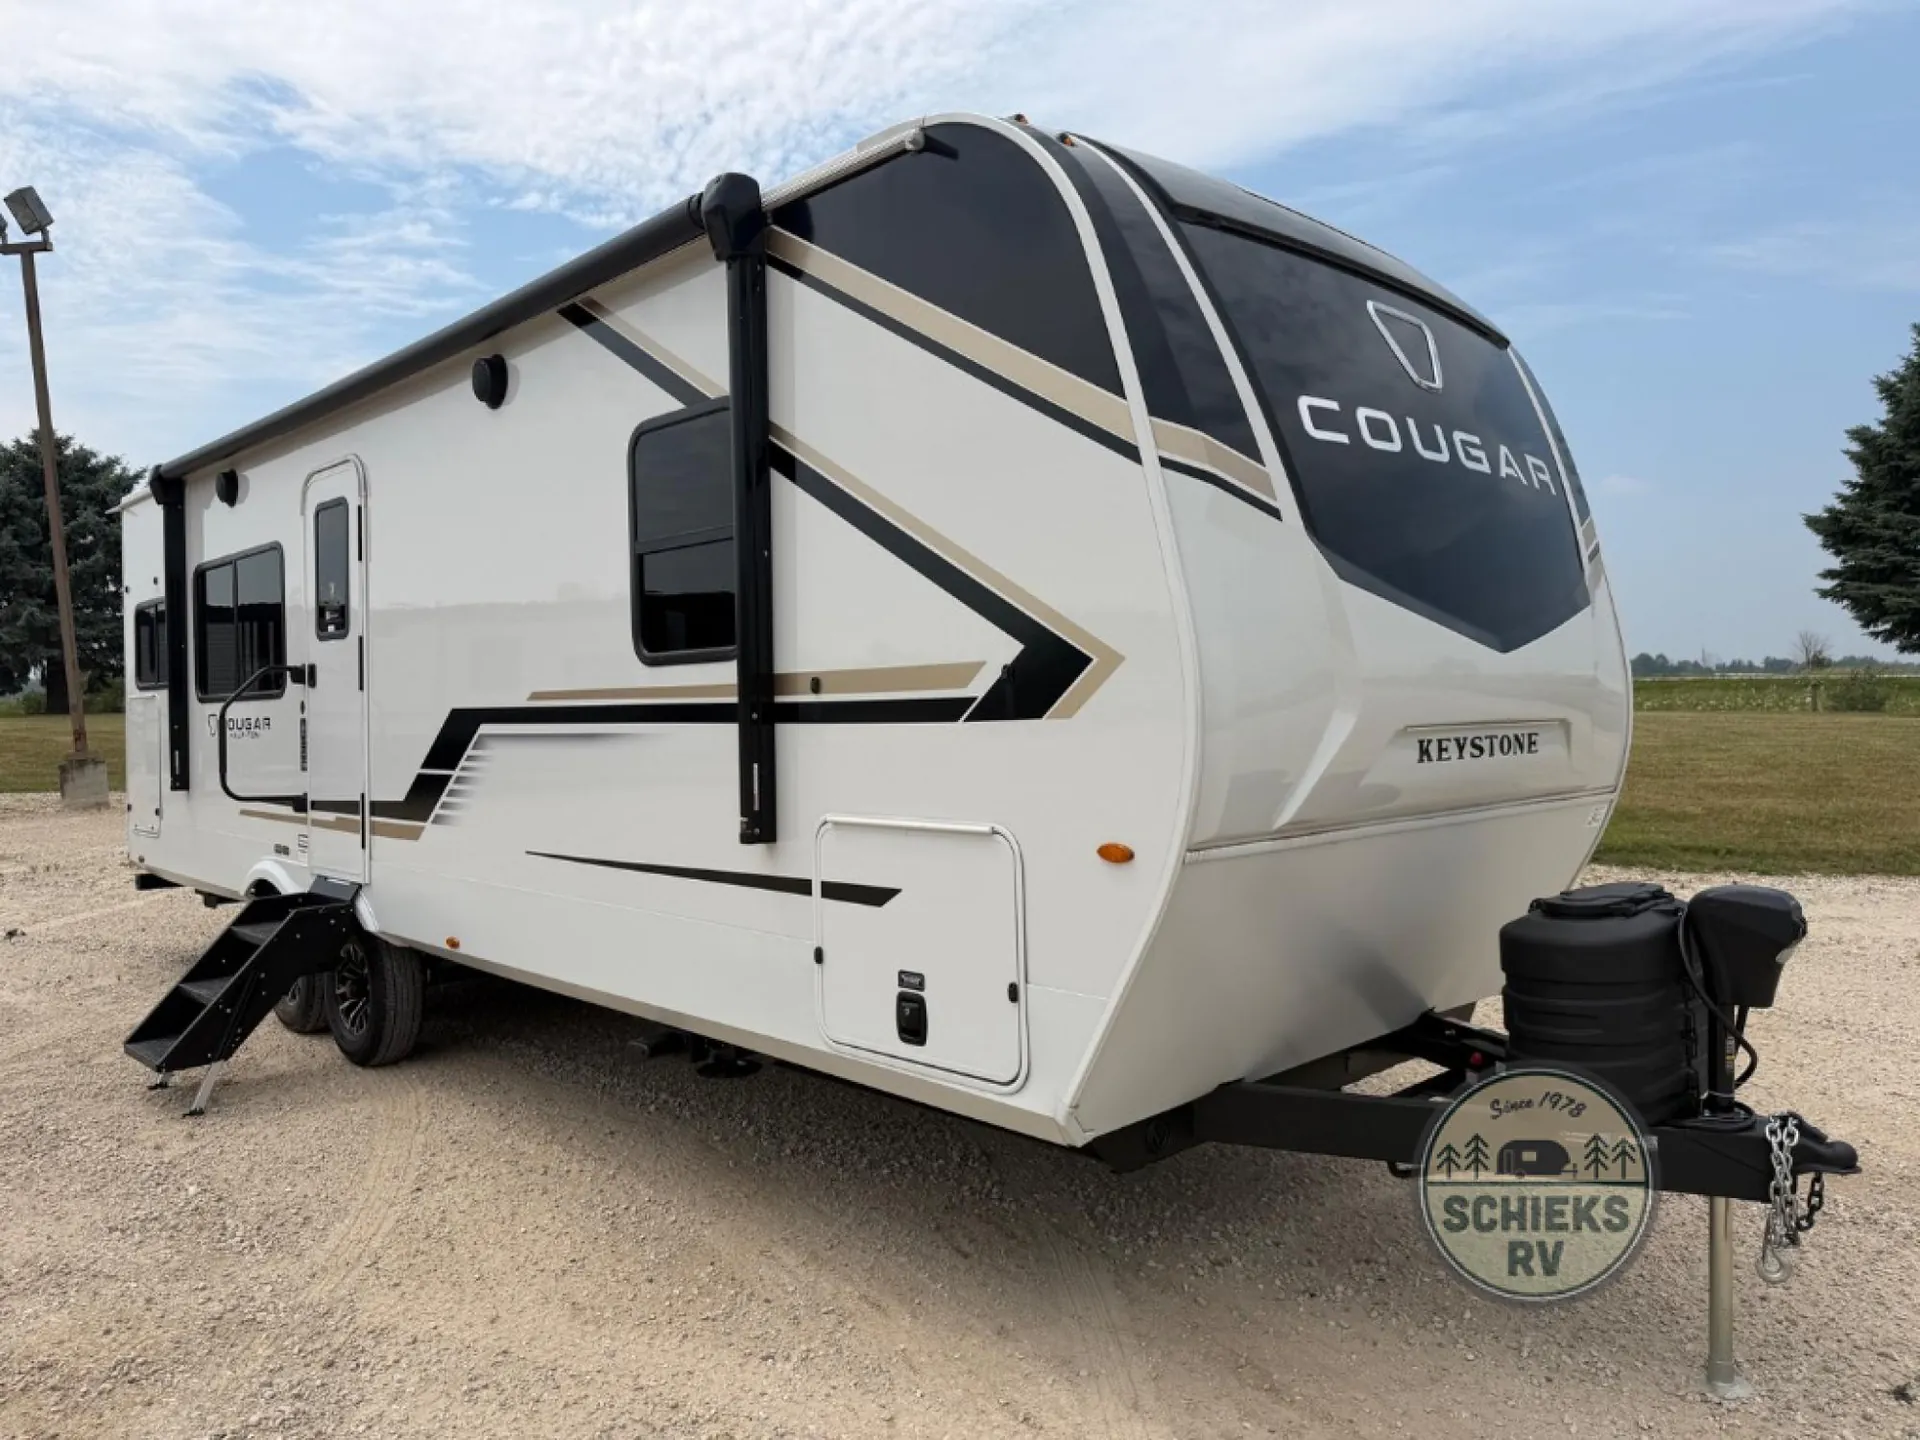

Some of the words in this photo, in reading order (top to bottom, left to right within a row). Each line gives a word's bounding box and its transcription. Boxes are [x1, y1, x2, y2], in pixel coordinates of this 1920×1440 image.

[1297, 394, 1557, 496] COUGAR
[217, 717, 271, 730] OUGAR
[1416, 732, 1540, 764] KEYSTONE
